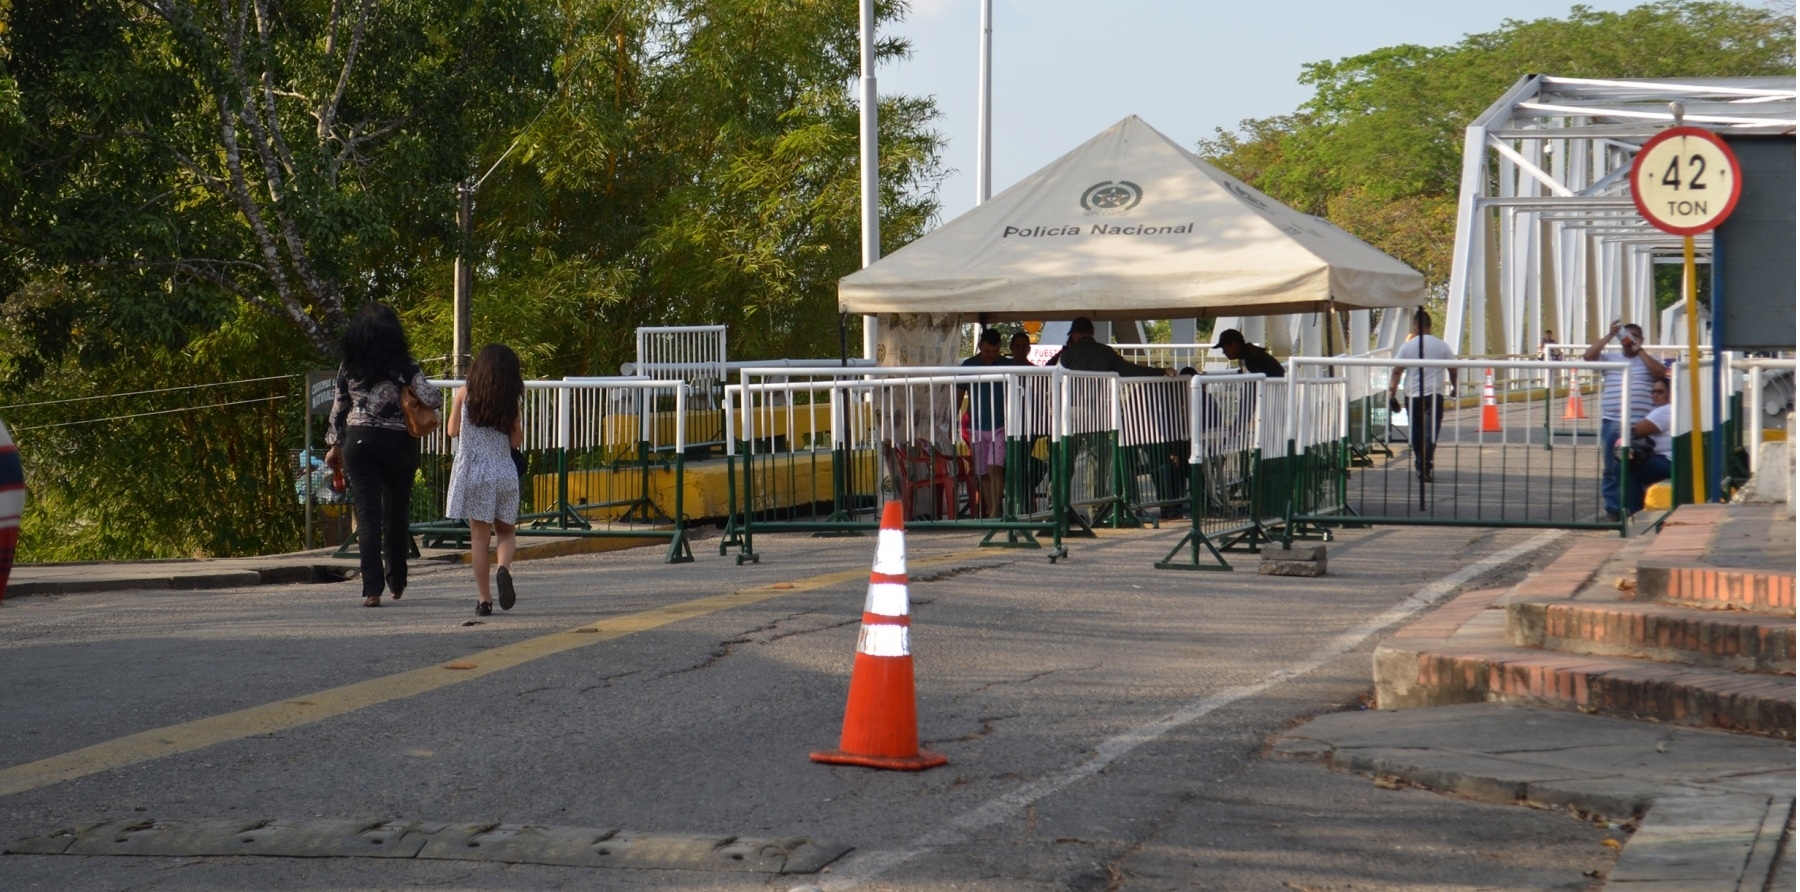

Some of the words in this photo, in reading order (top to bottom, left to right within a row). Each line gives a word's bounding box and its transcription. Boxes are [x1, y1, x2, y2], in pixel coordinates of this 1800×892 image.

[1661, 154, 1707, 191] 42
[1668, 201, 1707, 216] TON
[1002, 224, 1080, 239] Policía
[1090, 222, 1194, 236] Nacional
[1034, 348, 1058, 358] PUEST
[313, 389, 335, 408] NATURALE
